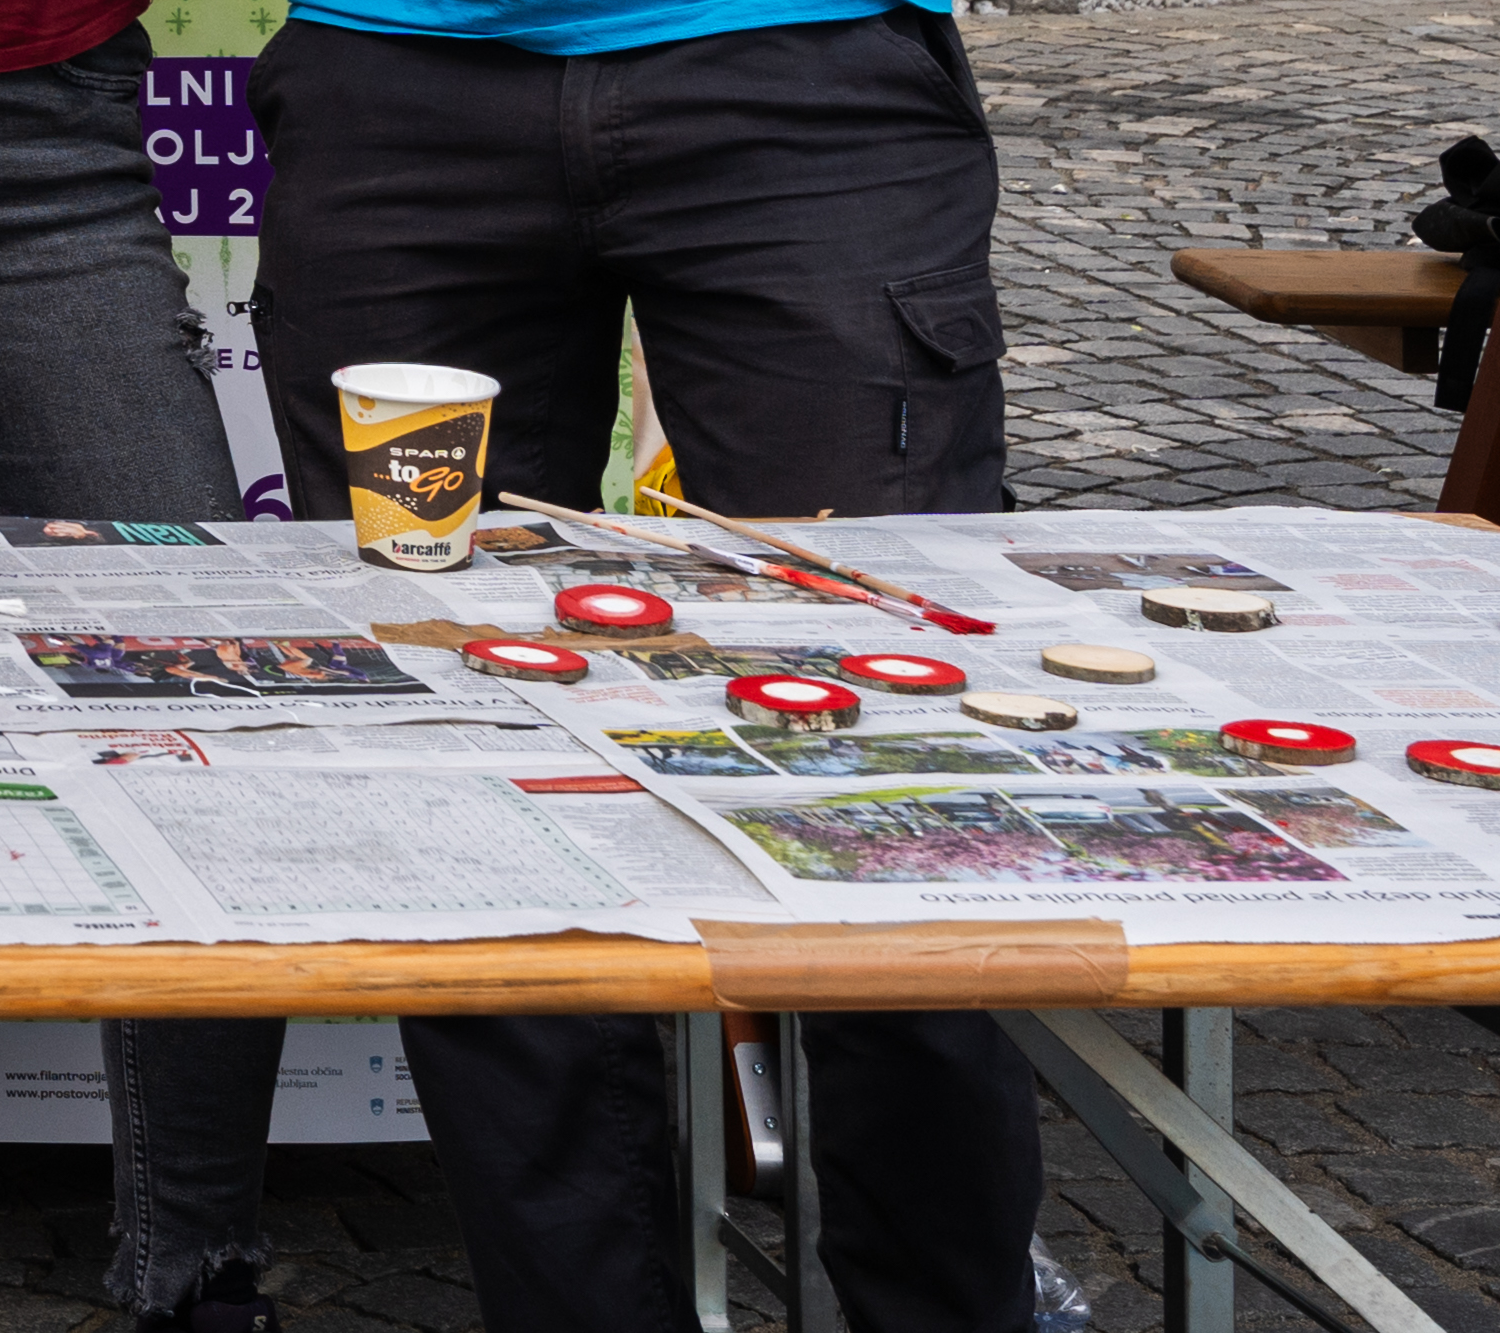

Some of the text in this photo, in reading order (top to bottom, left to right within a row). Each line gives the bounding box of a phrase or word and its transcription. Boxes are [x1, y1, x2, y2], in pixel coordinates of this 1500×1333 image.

[390, 448, 448, 458] SPAR
[410, 466, 464, 502] Go
[392, 540, 450, 556] barcaffé
[16, 698, 484, 715] Firencah prodalo svojo kožo
[1119, 706, 1206, 715] Vodenje
[920, 889, 1431, 905] dežju je pomlad prebudila mesto
[311, 1066, 343, 1076] občina
